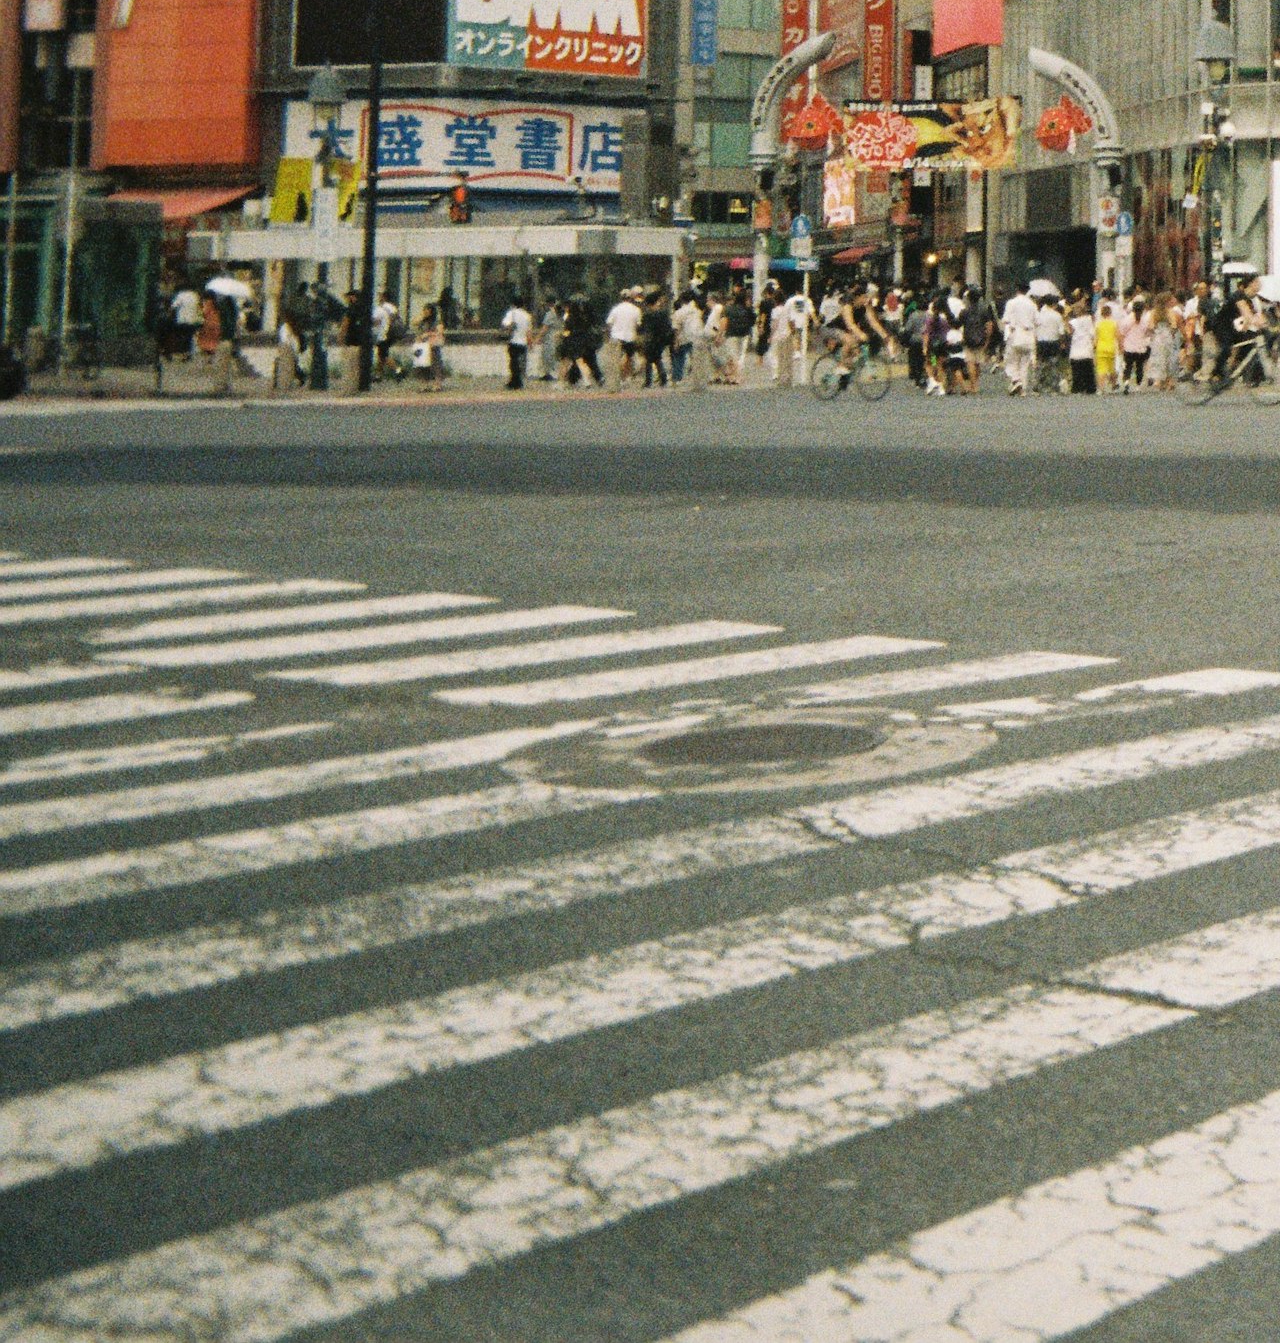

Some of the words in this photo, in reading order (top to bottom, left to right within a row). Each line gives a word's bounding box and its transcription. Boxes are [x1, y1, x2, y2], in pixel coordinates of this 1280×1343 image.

[455, 29, 642, 66] オンラインクリニック
[308, 118, 624, 175] 大盛堂書店
